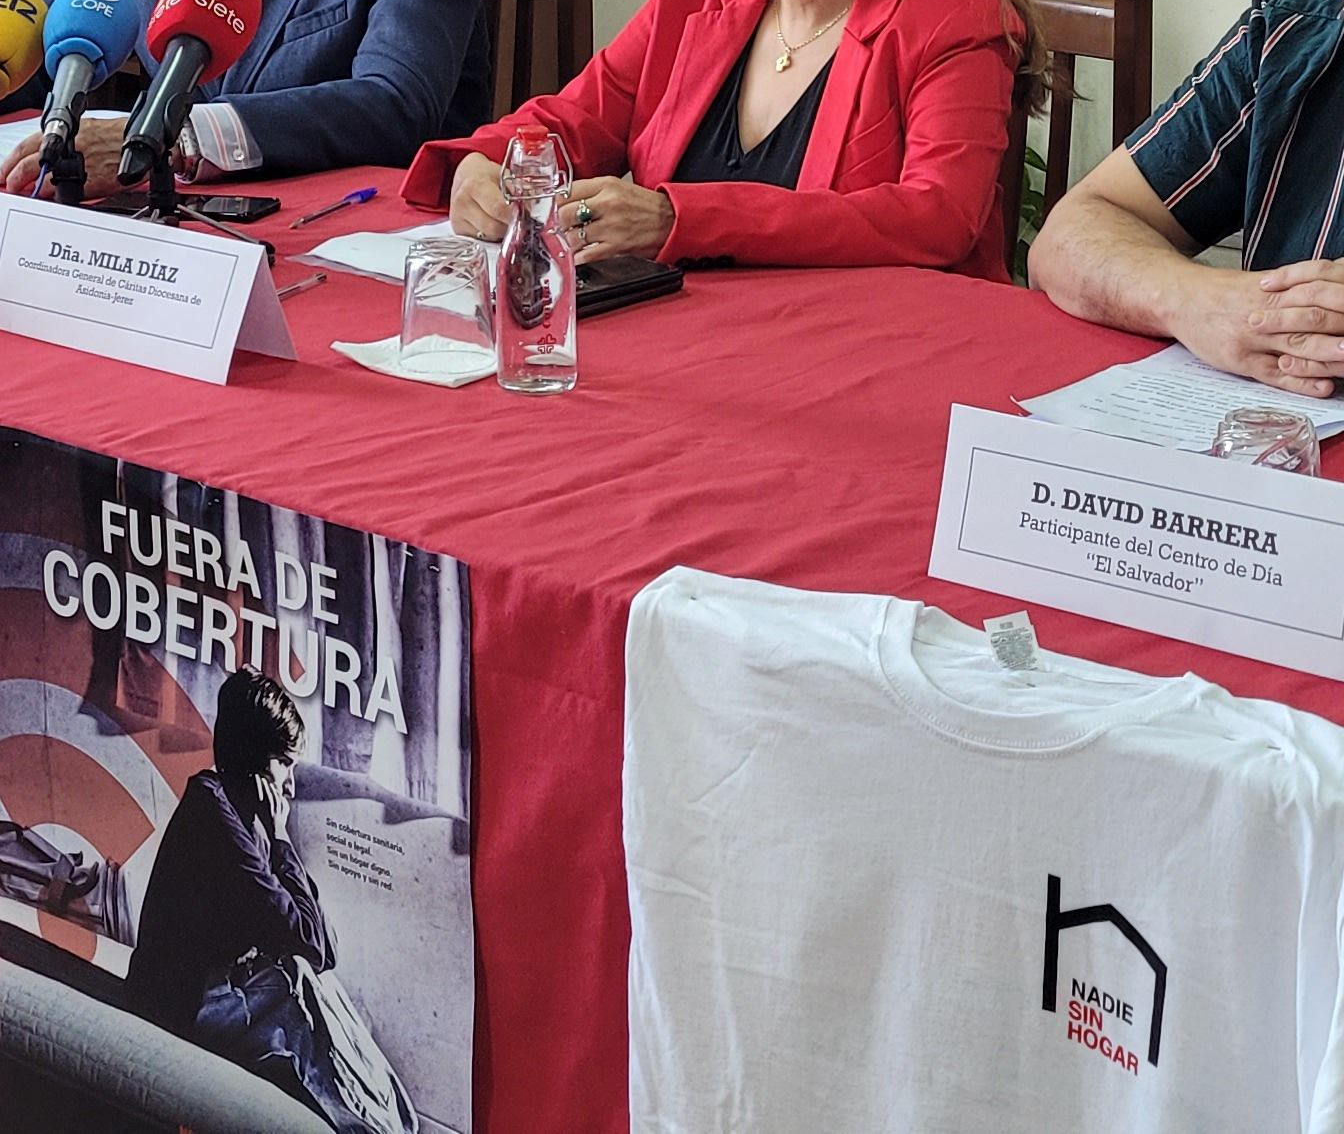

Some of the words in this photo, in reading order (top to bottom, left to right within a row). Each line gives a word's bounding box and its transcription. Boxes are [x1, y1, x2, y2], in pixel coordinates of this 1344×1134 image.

[18, 257, 70, 279] Coordinadora
[72, 269, 104, 285] General
[106, 276, 116, 287] de
[118, 279, 147, 294] Cáritas
[148, 285, 189, 304] Diocesana
[191, 295, 202, 306] de
[49, 242, 84, 265] Dña.
[87, 250, 132, 274] MILA
[136, 258, 179, 284] DÍAZ
[75, 284, 134, 306] Asidonia-Jerez
[1031, 482, 1056, 507] D.
[1061, 489, 1145, 526] DAVID
[1150, 507, 1279, 556] BARRERA
[101, 500, 262, 601] FUERA
[275, 549, 340, 626] DE
[1019, 512, 1121, 551] Participante
[1124, 535, 1153, 558] del
[1158, 543, 1220, 572] Centro
[1223, 557, 1248, 578] de
[1252, 562, 1283, 588] Día
[1086, 551, 1112, 574] “El
[1116, 557, 1204, 594] Salvador”
[43, 549, 408, 736] COBERTURA
[326, 817, 337, 829] Sin
[339, 823, 371, 842] cobertura
[373, 835, 405, 856] sanitaria,
[326, 833, 346, 846] social
[327, 845, 338, 857] Sin
[340, 851, 348, 861] un
[350, 853, 369, 868] hogar
[328, 859, 339, 870] Sin
[341, 865, 361, 879] apoyo
[369, 877, 379, 886] sin
[1068, 999, 1104, 1032] SIN
[1071, 978, 1134, 1026] NADIE
[1067, 1021, 1139, 1076] HOGAR
